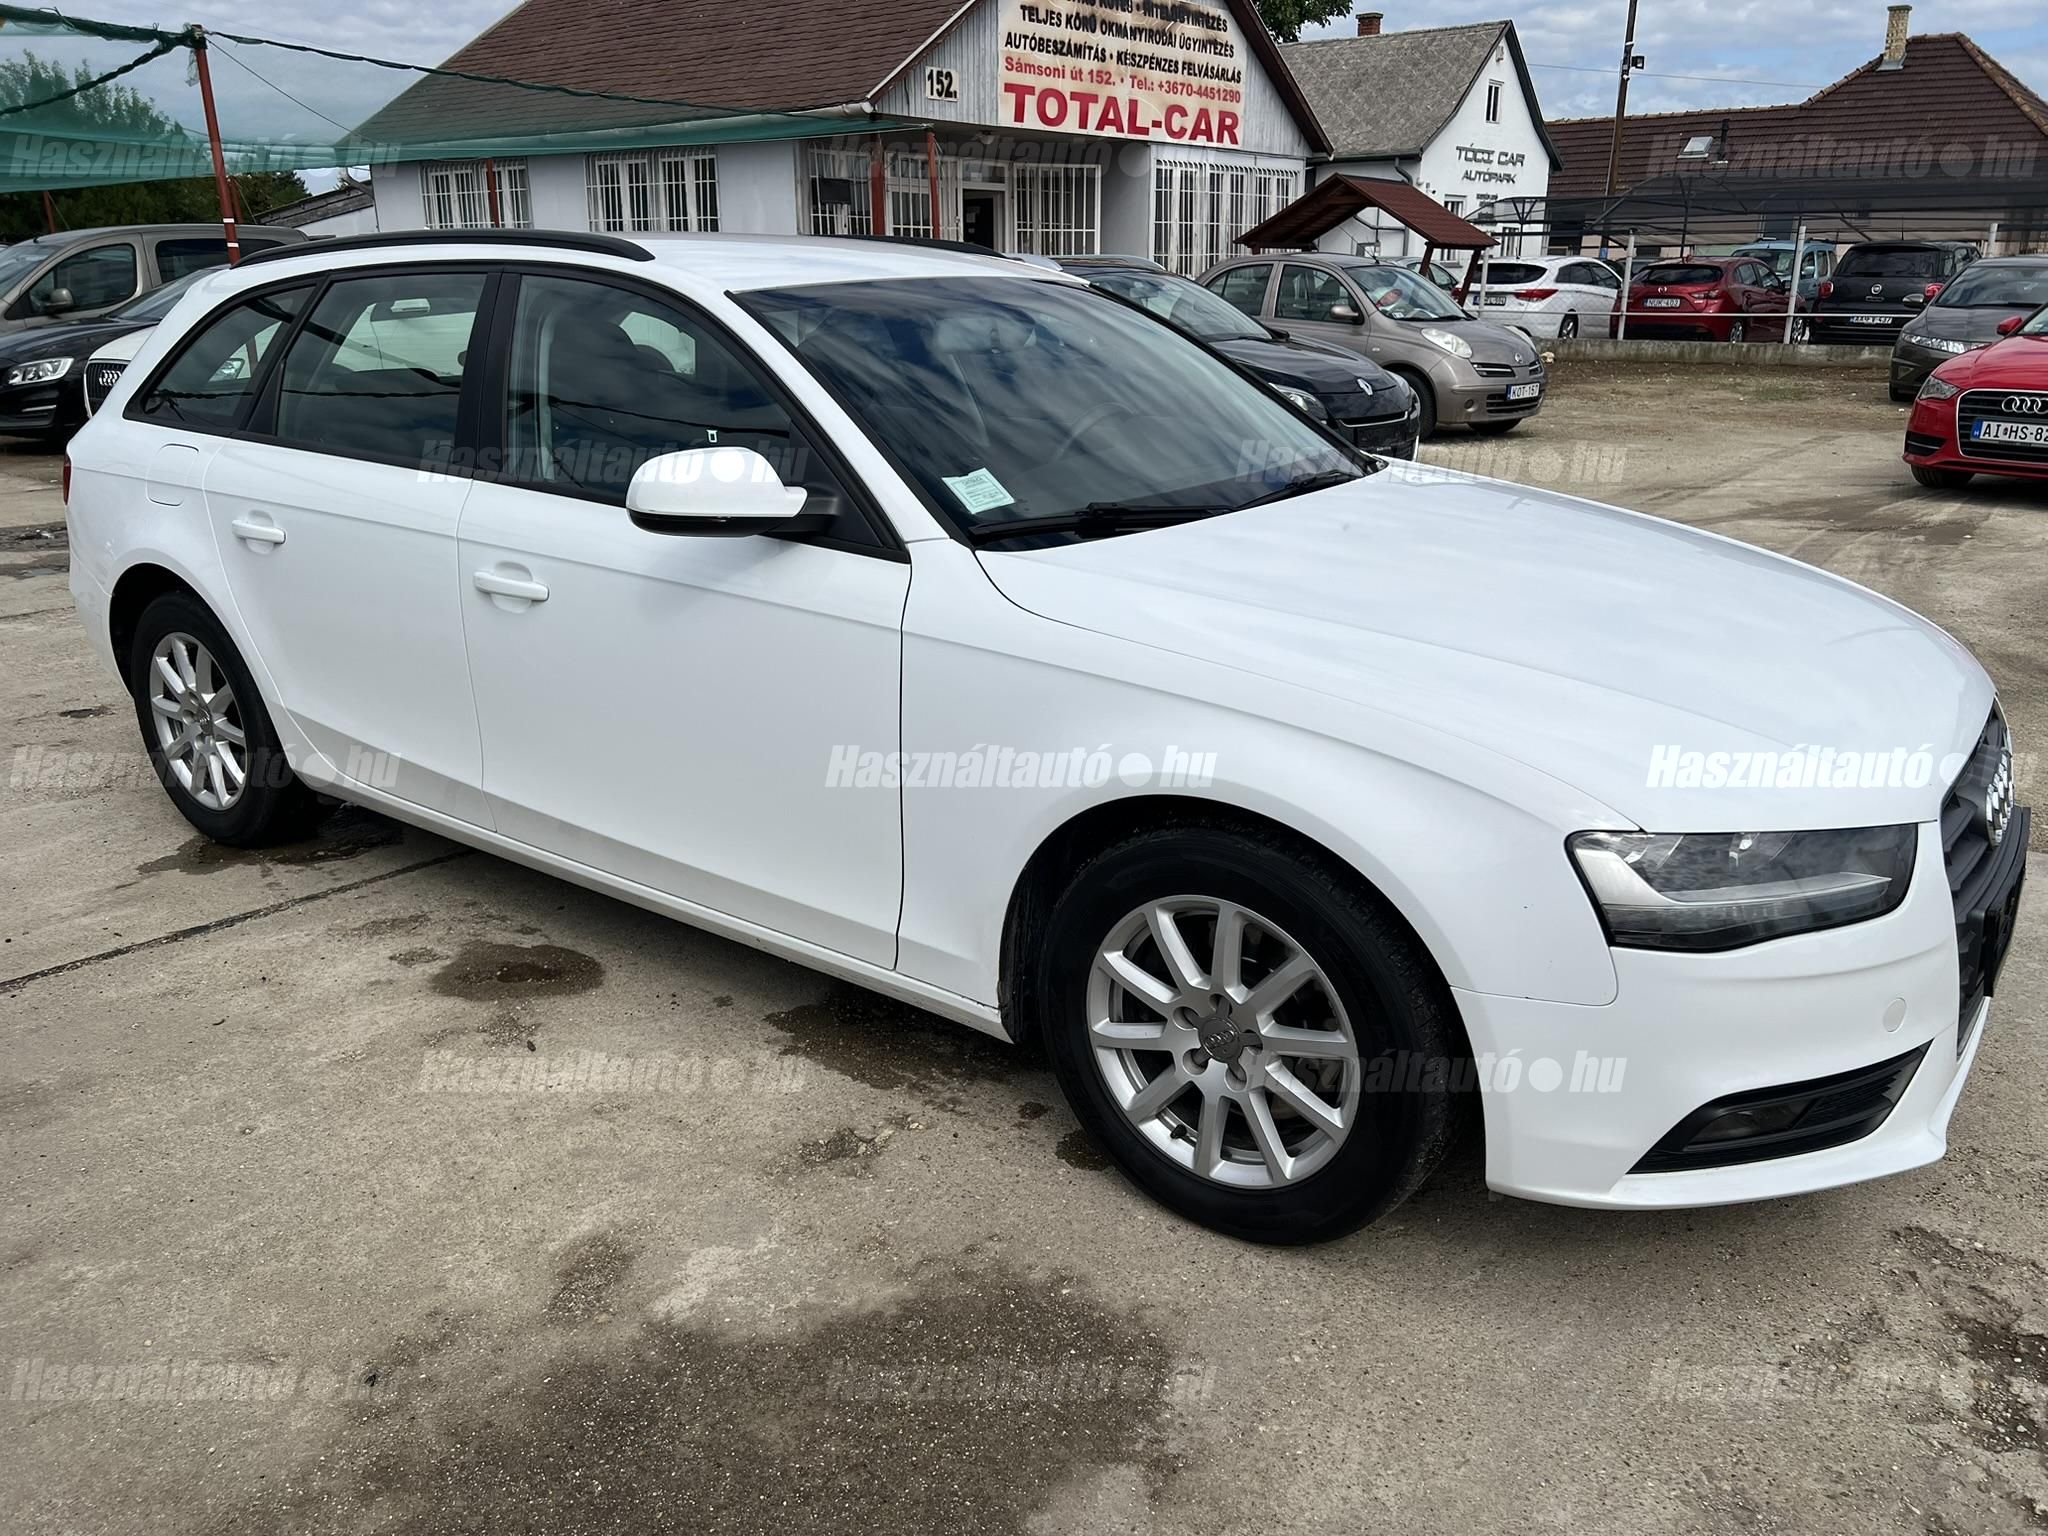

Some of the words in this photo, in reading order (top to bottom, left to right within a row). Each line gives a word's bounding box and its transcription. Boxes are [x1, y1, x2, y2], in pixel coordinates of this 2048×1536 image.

[1020, 4, 1062, 28] TELJES
[1100, 18, 1177, 48] OKMÁNYIRODAI
[1179, 32, 1234, 58] ÜGYINTÉZÉS
[1005, 32, 1106, 63] AUTÓBESZÁMÍTÁS
[1116, 48, 1179, 74] KÉSZPÉNZES
[1182, 60, 1242, 84] FELVÁSÁRLÁS
[1005, 56, 1065, 79] Sámsoni
[1070, 65, 1083, 82] út
[1088, 69, 1116, 86] 152.
[1129, 75, 1154, 92] Tel.:
[1158, 80, 1241, 103] +3670-4451290
[927, 69, 957, 98] 152.
[1004, 82, 1240, 145] TOTAL-CAR
[1461, 168, 1516, 184] AUTÓPARK
[1497, 151, 1525, 167] CAR
